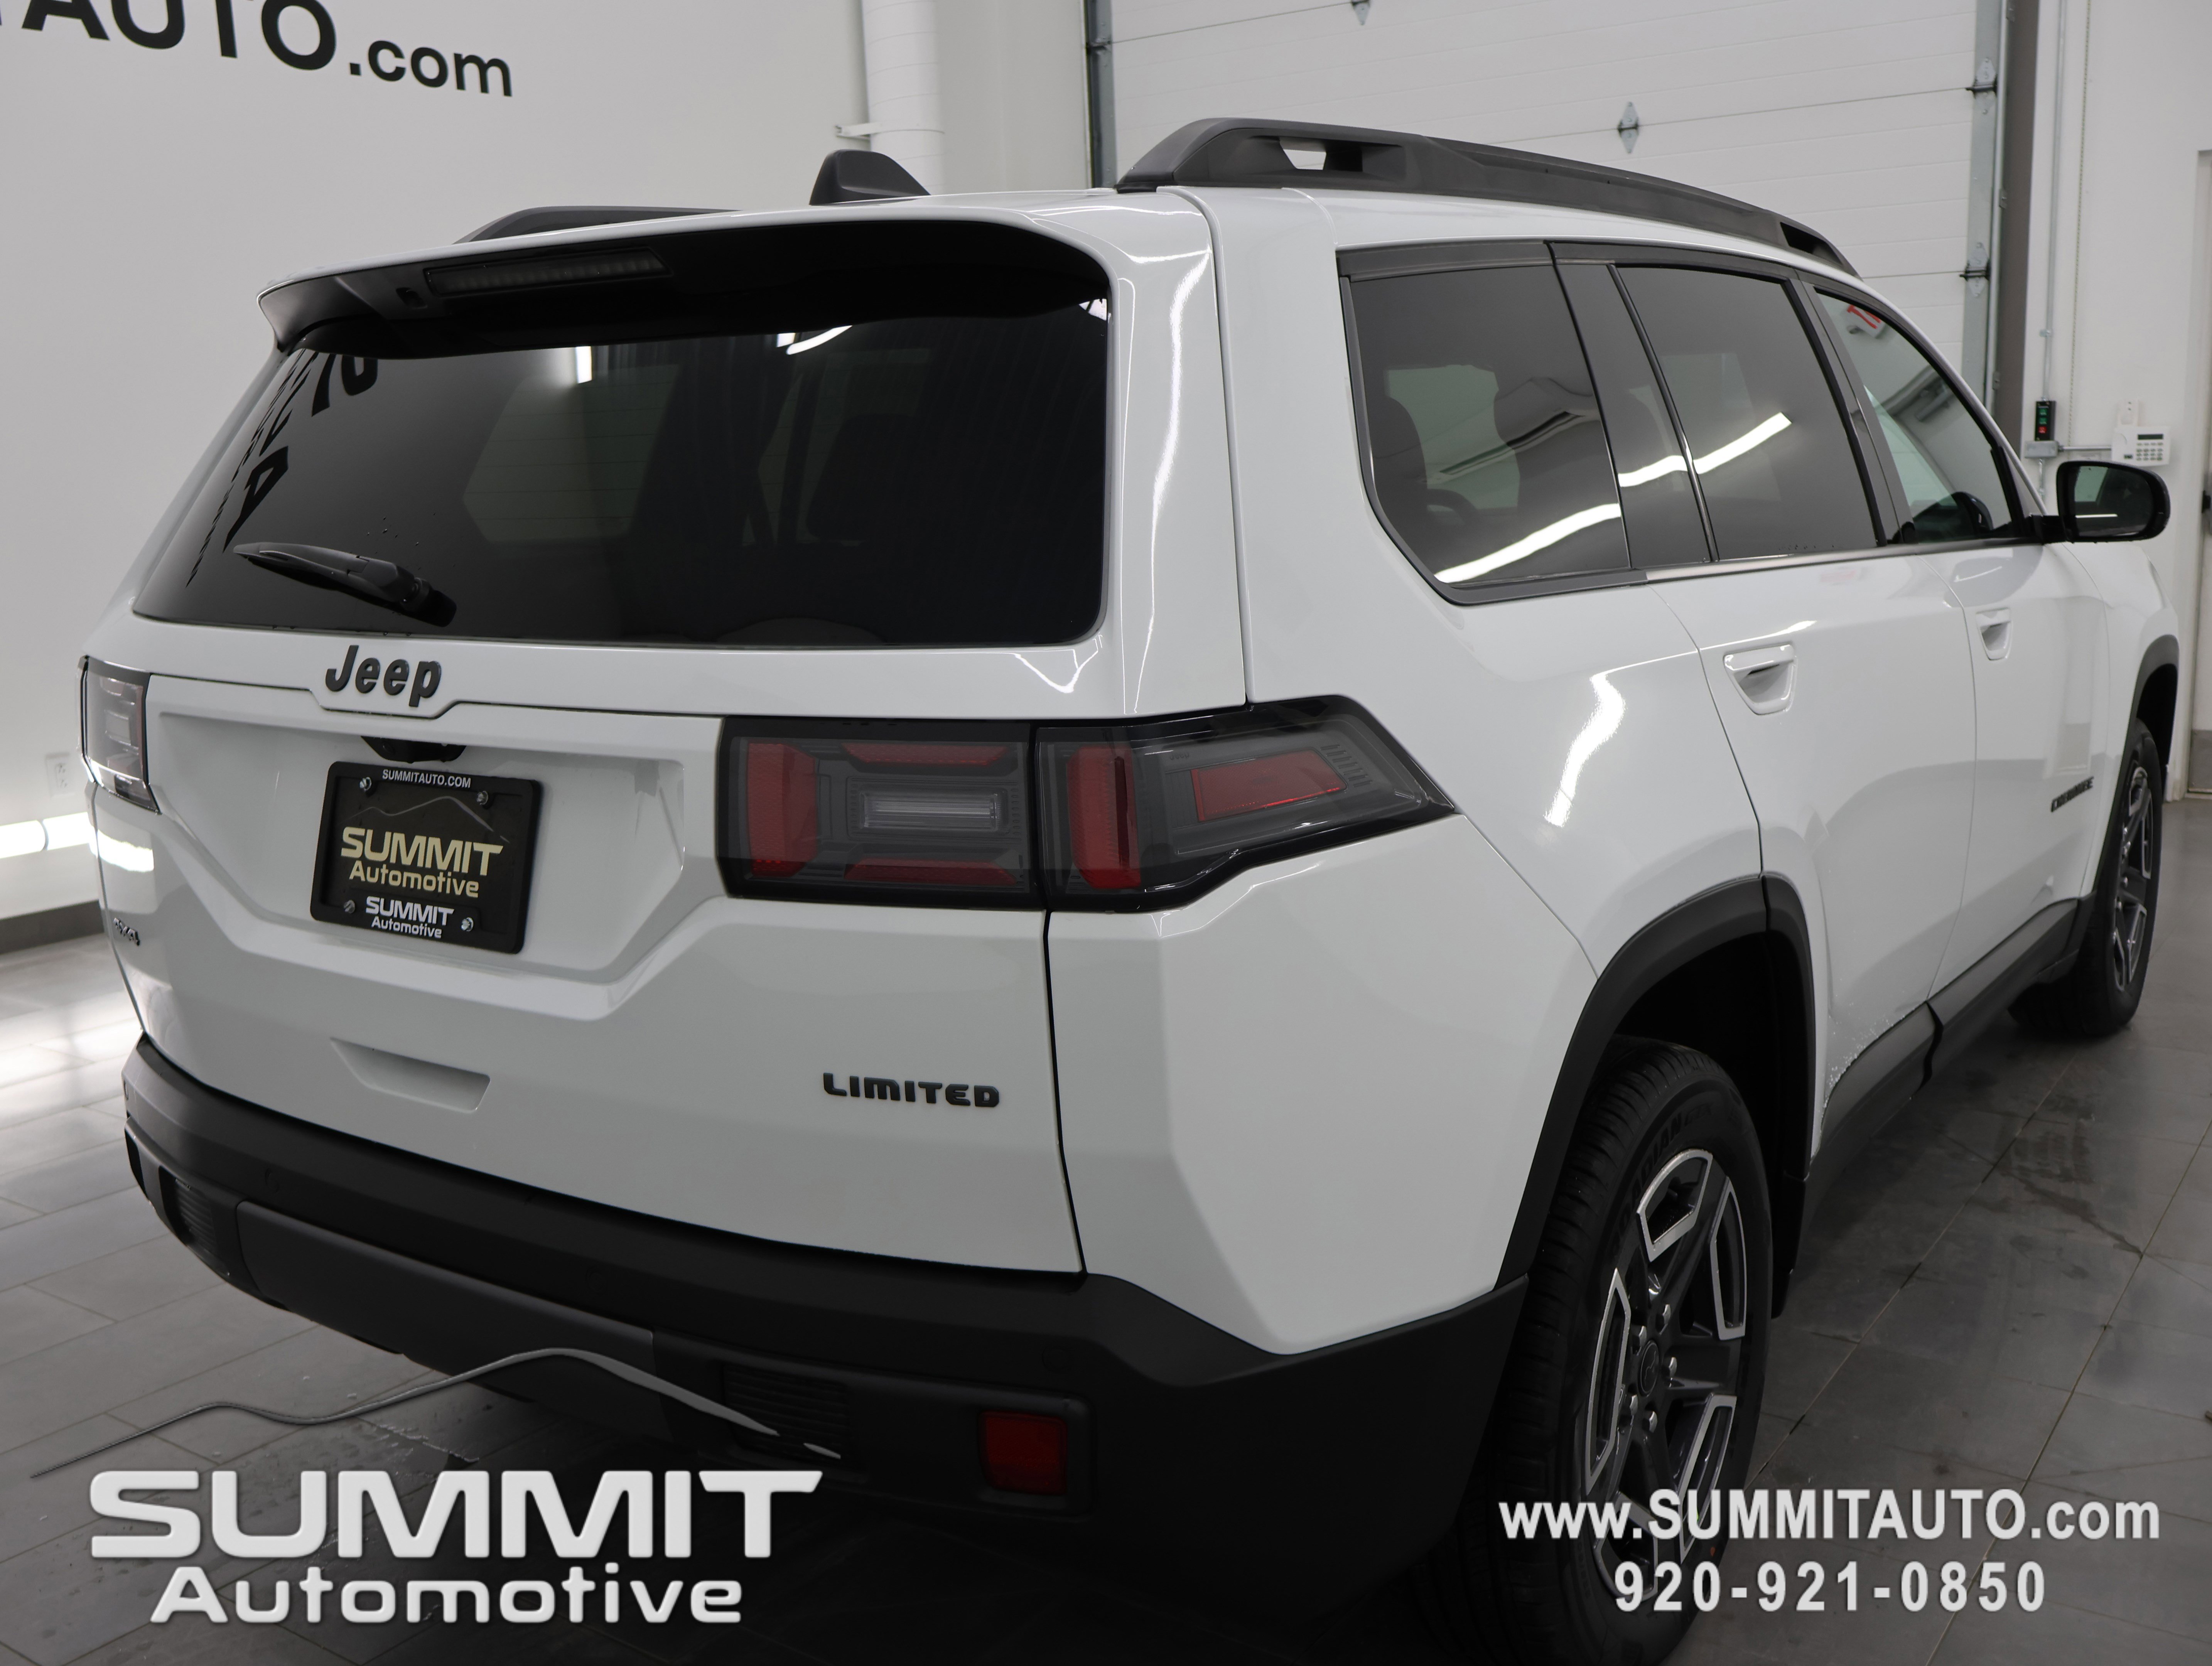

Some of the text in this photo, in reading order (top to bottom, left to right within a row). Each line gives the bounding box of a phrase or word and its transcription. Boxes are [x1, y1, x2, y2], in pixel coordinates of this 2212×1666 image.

[0, 0, 512, 97] AUTO.com
[325, 644, 441, 707] Jeep
[382, 769, 471, 788] SUMMITAUTO.COM
[341, 826, 503, 876] SUMMIT
[349, 860, 479, 898] Automotive
[365, 896, 454, 926] SUMMIT
[371, 916, 442, 938] Automotive
[823, 1072, 1000, 1108] LIMITED
